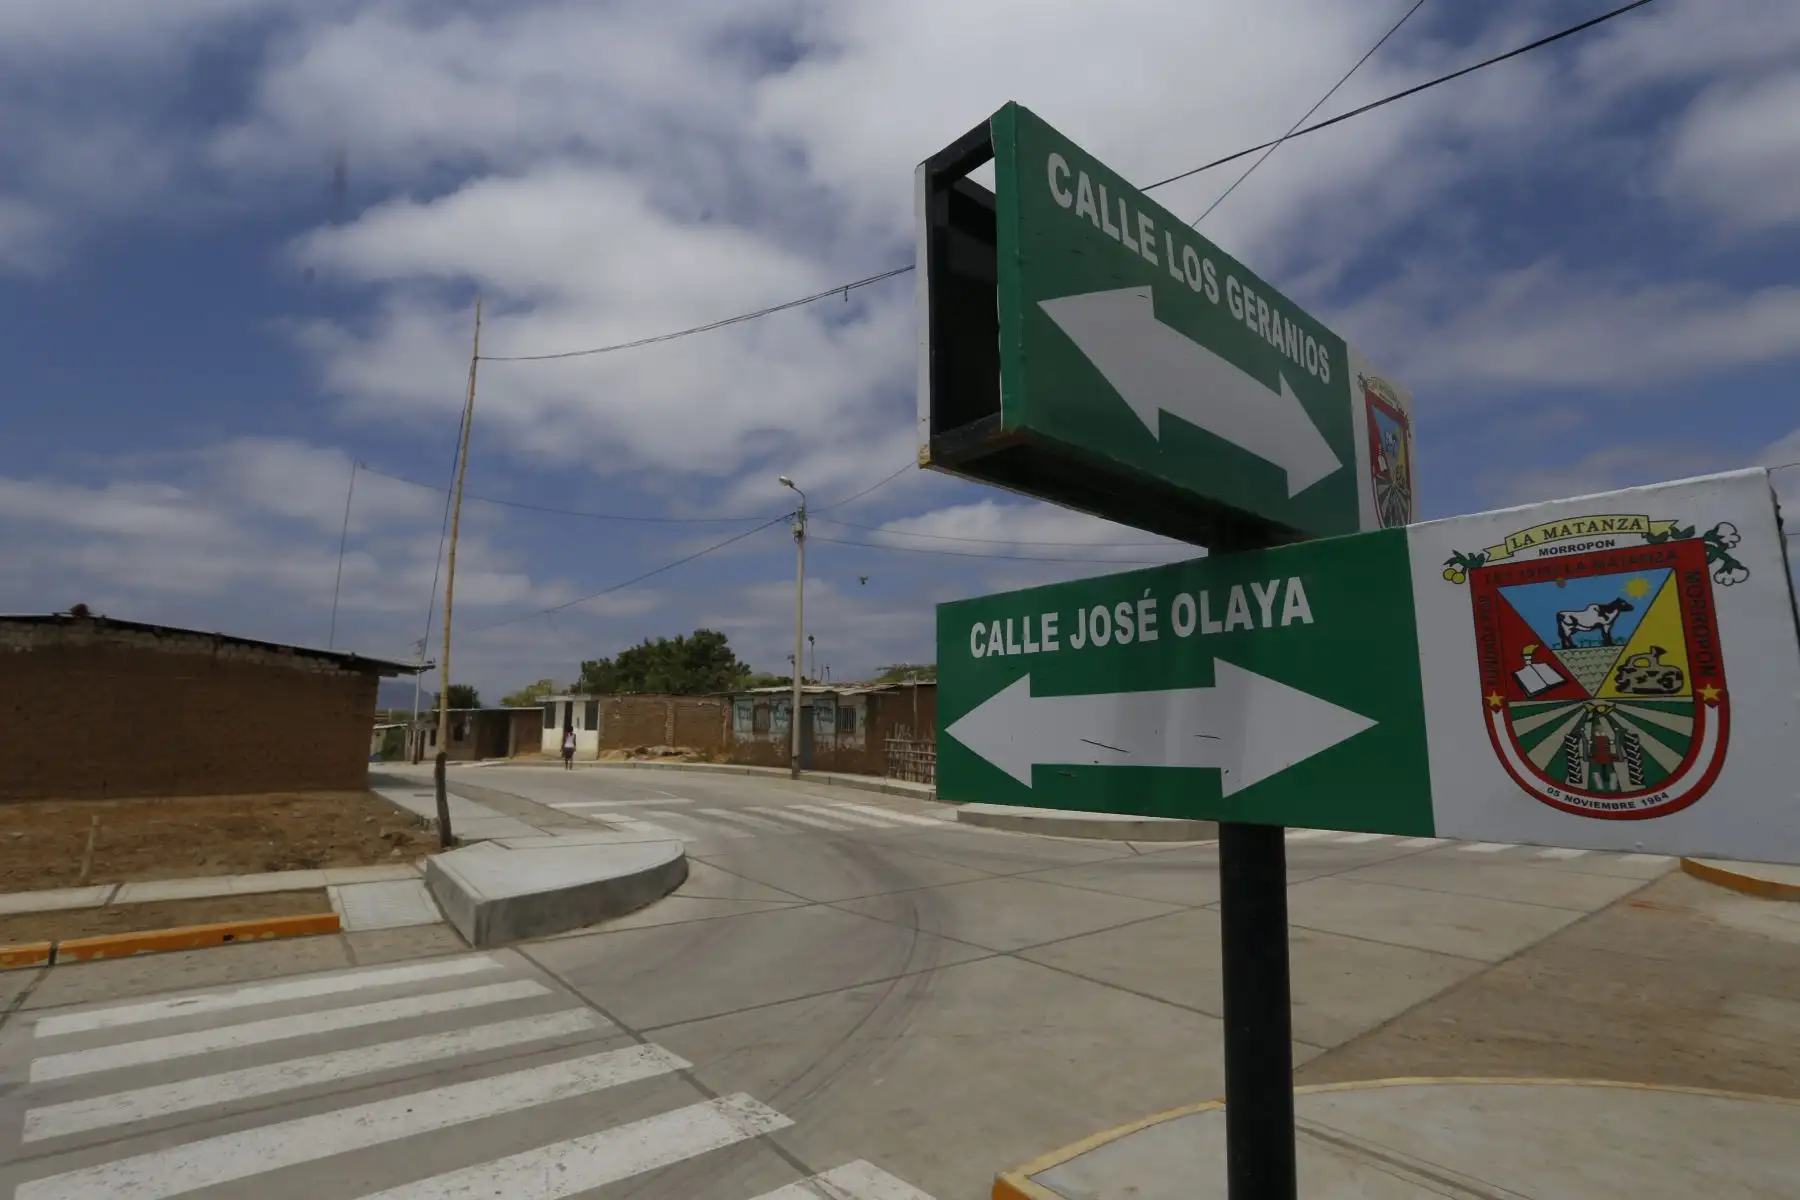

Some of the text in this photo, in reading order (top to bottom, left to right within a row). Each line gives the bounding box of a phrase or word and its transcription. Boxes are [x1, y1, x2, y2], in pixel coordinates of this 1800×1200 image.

[1047, 152, 1330, 384] CALLE LOS GERANIOS
[1511, 518, 1644, 549] LA MATANZA
[1538, 538, 1616, 557] MORROPON
[1592, 550, 1677, 569] MATANZA
[970, 576, 1314, 659] CALLE JOSÉ OLAYA
[1546, 786, 1670, 810] 05 NOVIEMBRE 1964
